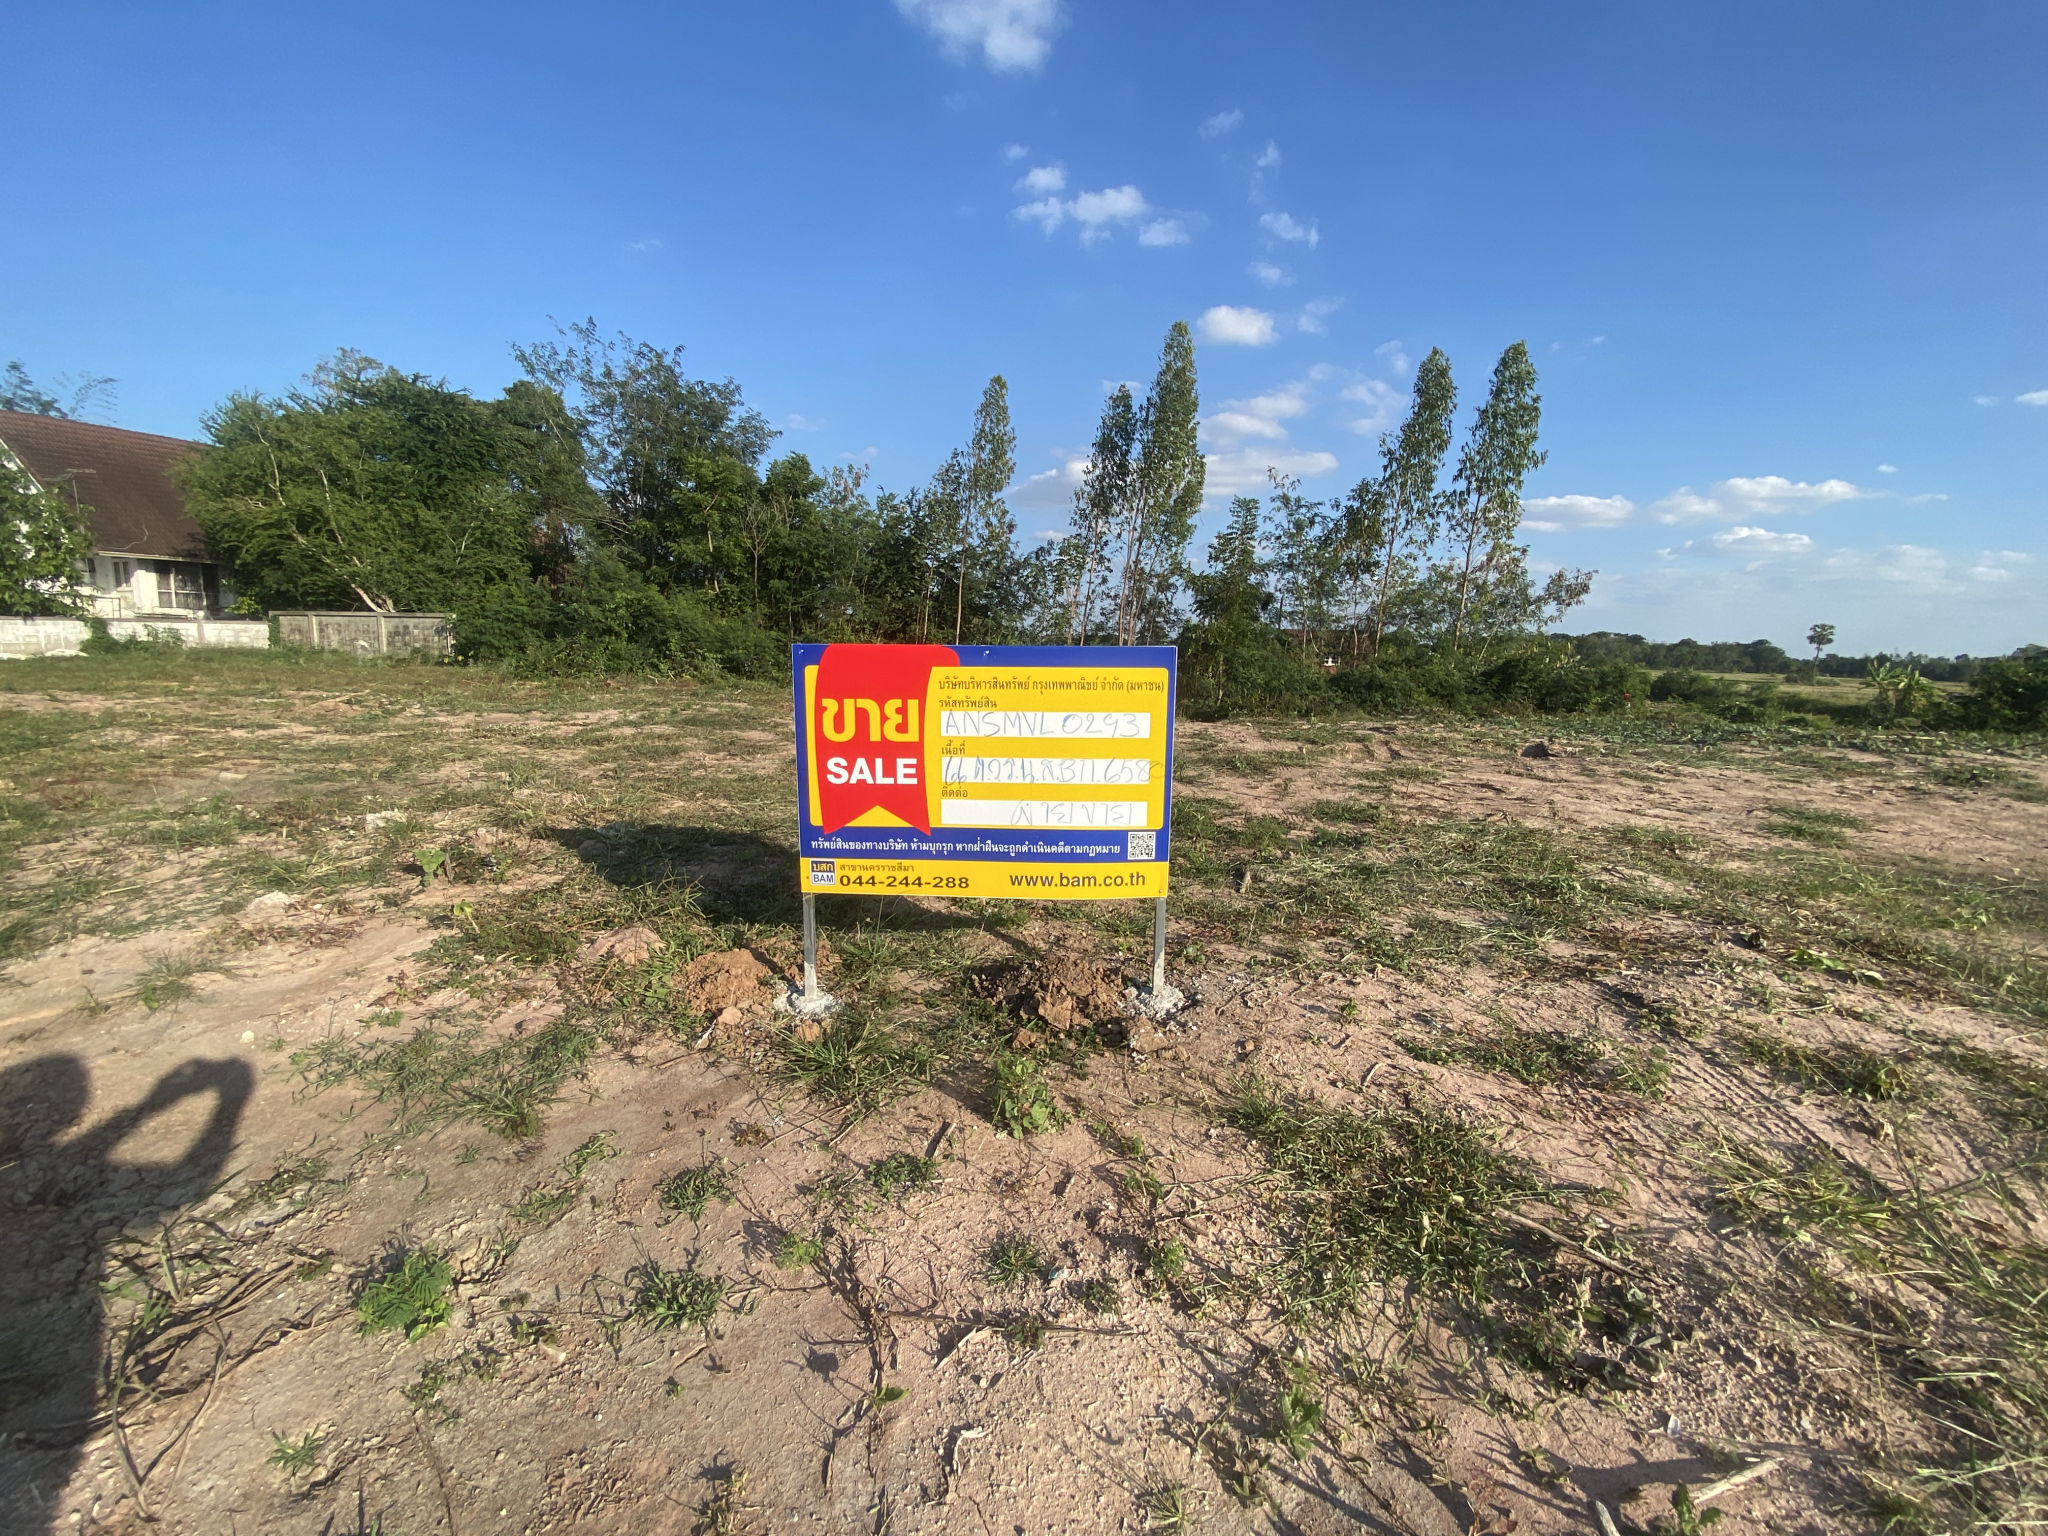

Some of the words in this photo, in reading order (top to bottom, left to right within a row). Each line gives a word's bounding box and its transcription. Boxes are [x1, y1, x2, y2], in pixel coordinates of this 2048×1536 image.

[938, 675, 1031, 690] บริษัทบริหารสินทรัพย์
[1033, 676, 1098, 695] กรุงเทพพาณิชย์
[1101, 677, 1124, 692] จำกัด
[1126, 680, 1165, 693] (มหาชน)
[938, 695, 998, 709] รหัสทรัพย์สิน
[821, 698, 920, 743] ขาย
[941, 740, 966, 755] เนื้อที่
[826, 757, 918, 785] SALE
[941, 785, 968, 798] ติดต่อ
[811, 836, 909, 850] ทรัพย์สินของทางบริษัท
[911, 838, 954, 855] ห้ามบุกรุก
[840, 862, 915, 873] สาขานครราชสีมา
[813, 874, 834, 884] BAM
[839, 875, 970, 889] 044-244-288
[1009, 872, 1146, 887] www.bam.co.th
